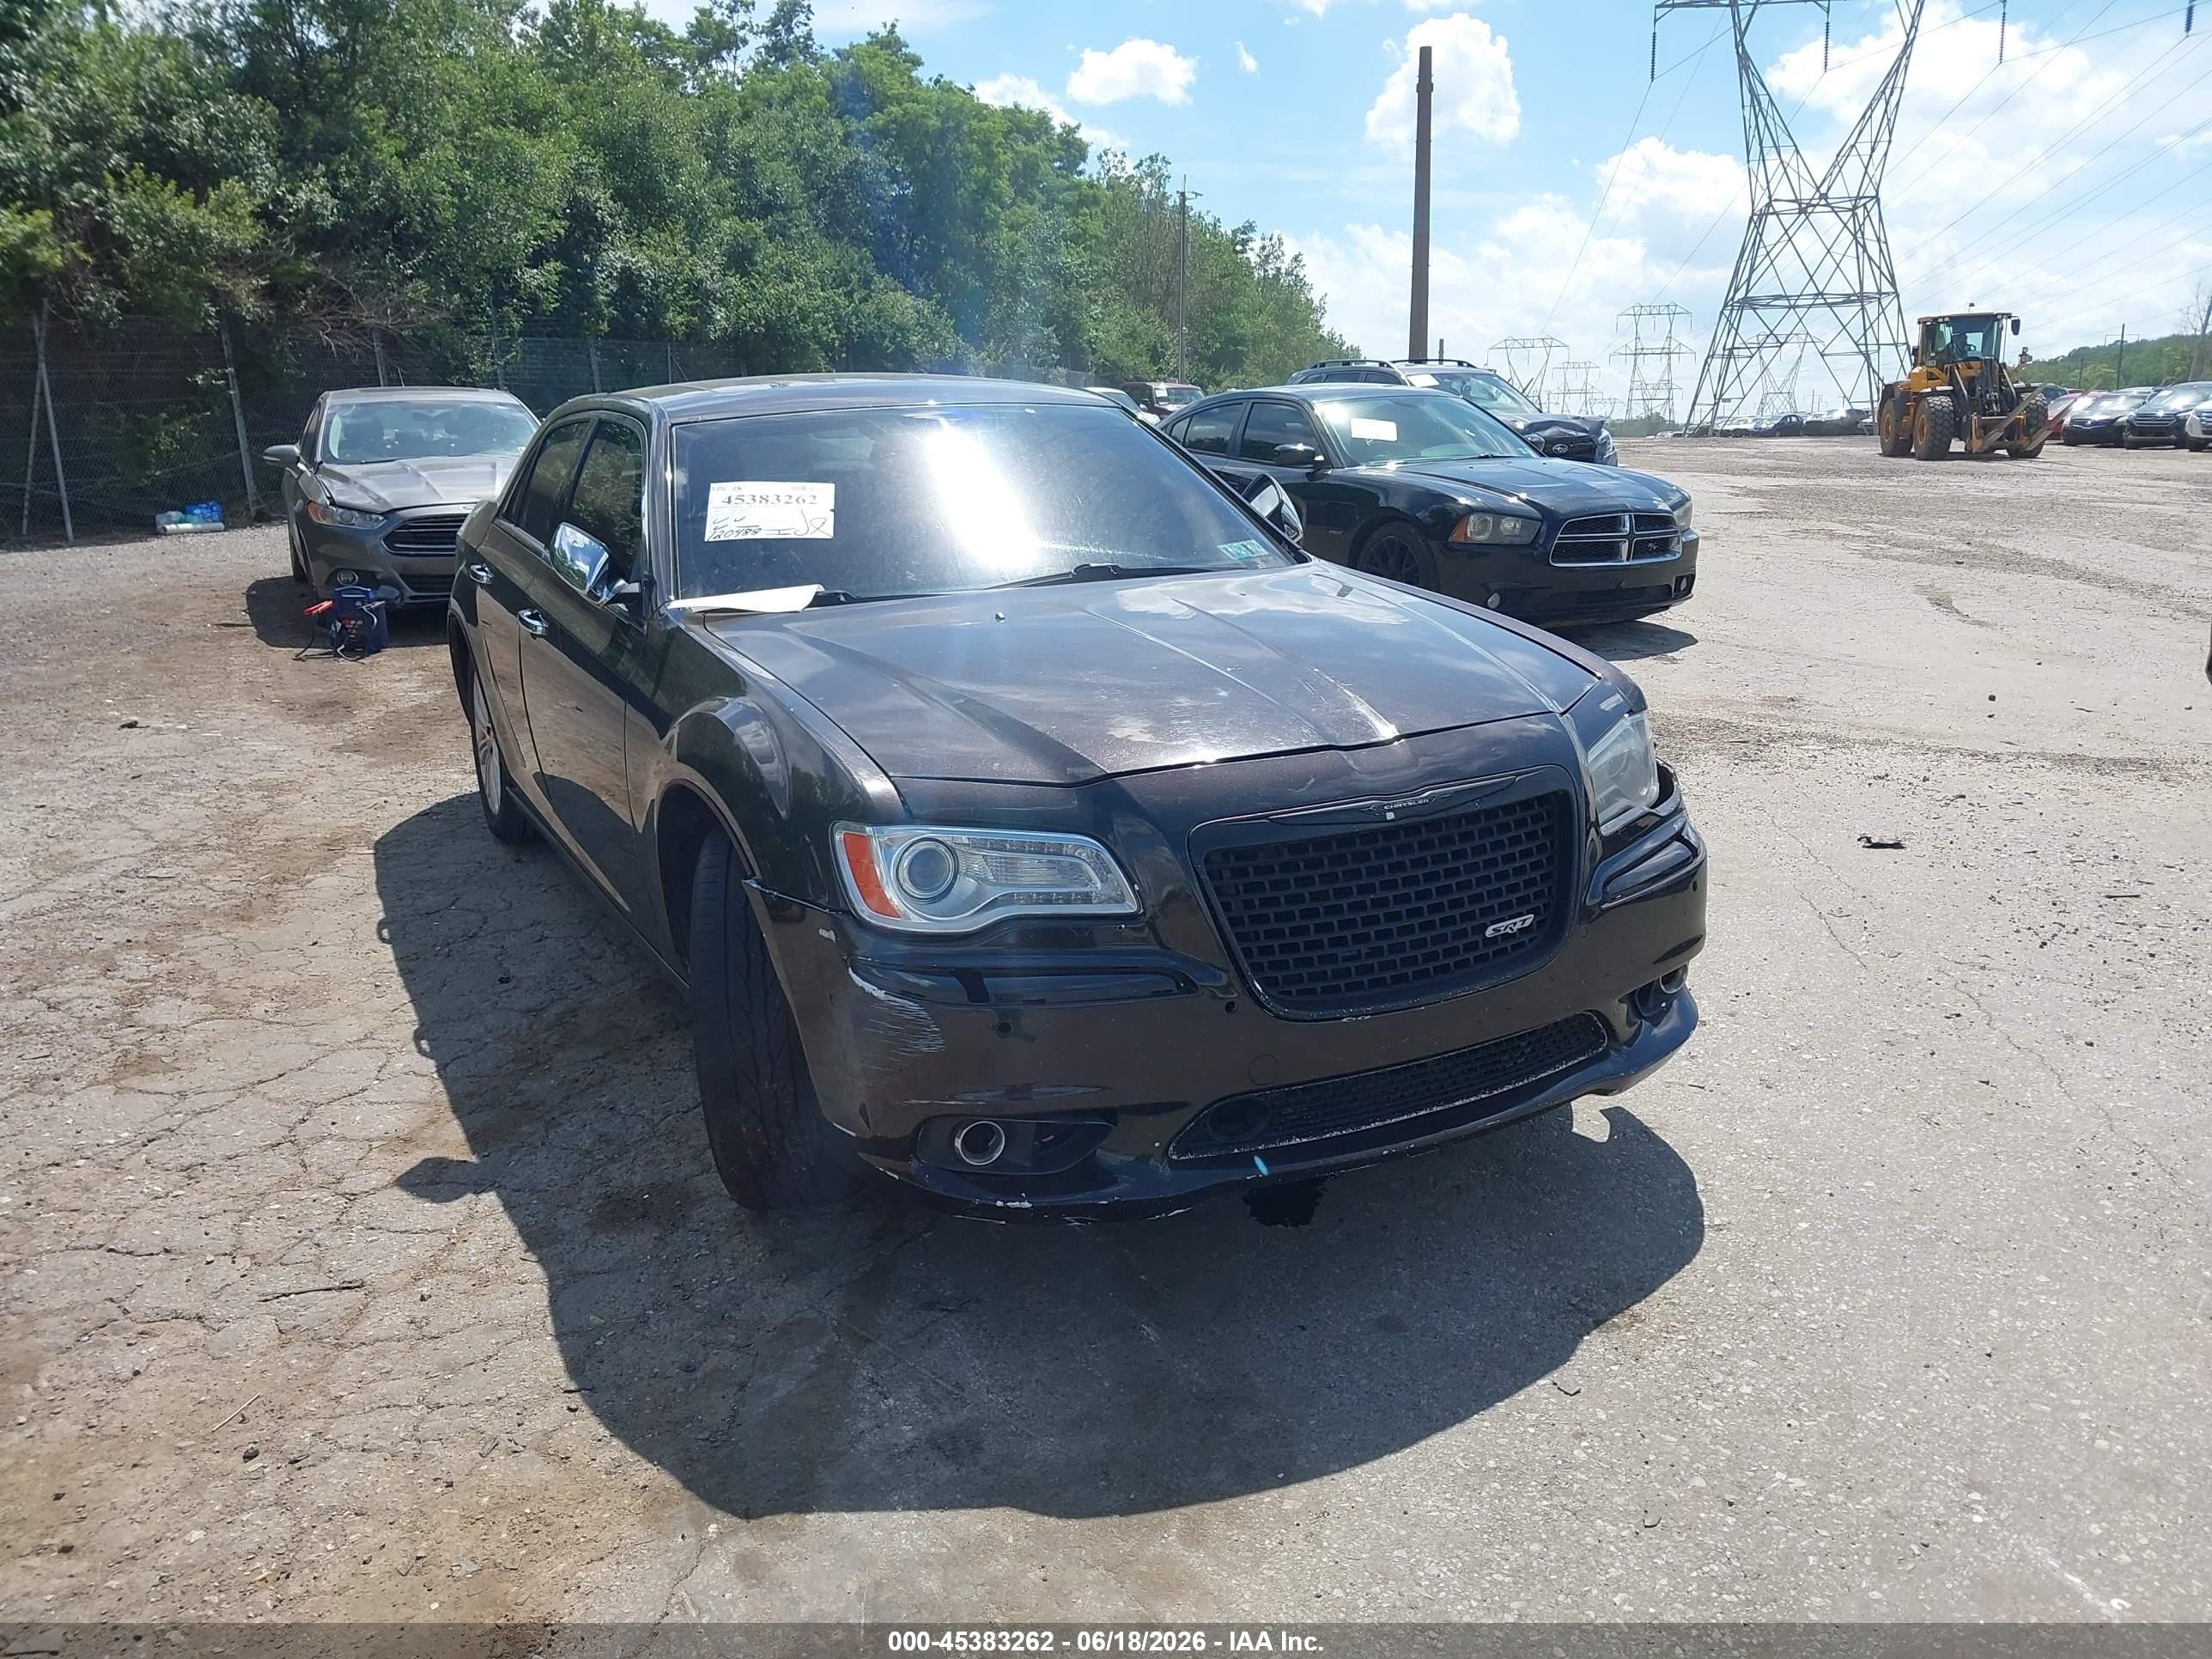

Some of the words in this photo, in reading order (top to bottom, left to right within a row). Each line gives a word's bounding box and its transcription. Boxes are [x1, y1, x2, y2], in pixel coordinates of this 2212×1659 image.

[721, 494, 817, 505] 45383262
[1384, 799, 1429, 810] CHRYSLER
[1485, 914, 1534, 938] SRT
